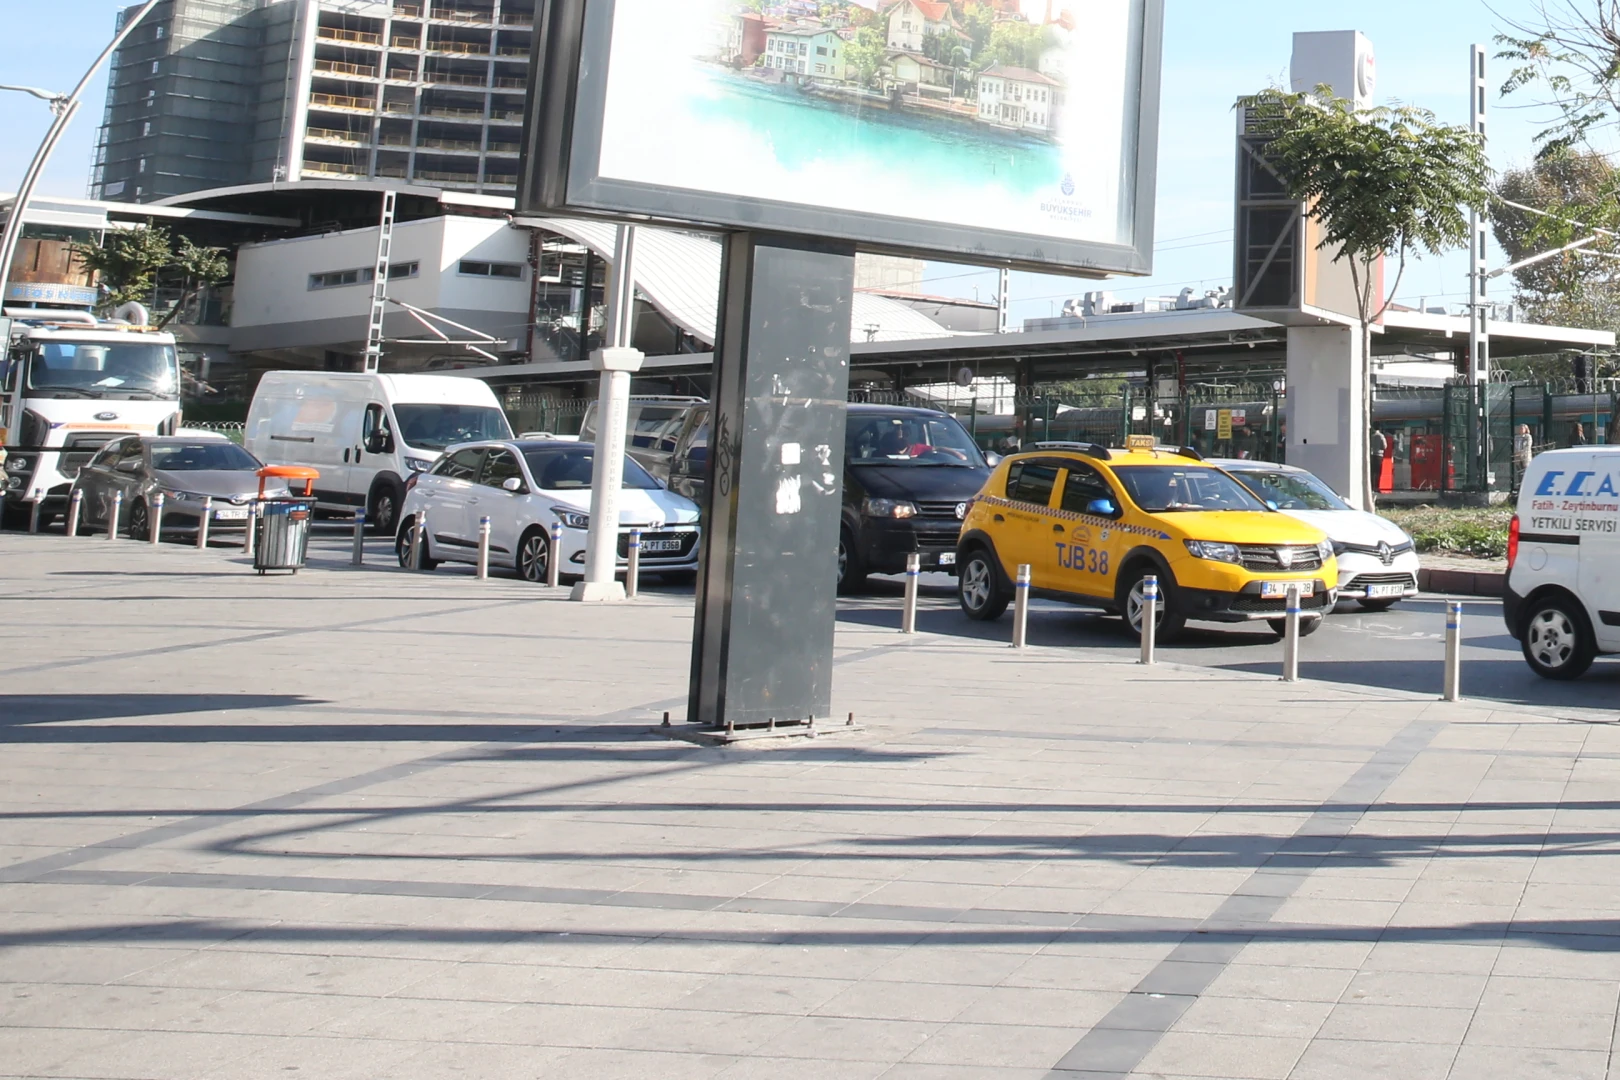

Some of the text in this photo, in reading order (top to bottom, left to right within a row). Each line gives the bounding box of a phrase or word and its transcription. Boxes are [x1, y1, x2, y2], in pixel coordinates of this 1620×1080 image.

[1531, 500, 1555, 511] Fatih
[1562, 501, 1618, 513] Zeytinburnu
[1531, 515, 1572, 530] YETKİLİ
[651, 541, 659, 550] PT
[1055, 542, 1109, 575] TJB 38
[1268, 583, 1276, 594] 34
[1302, 582, 1311, 593] 38
